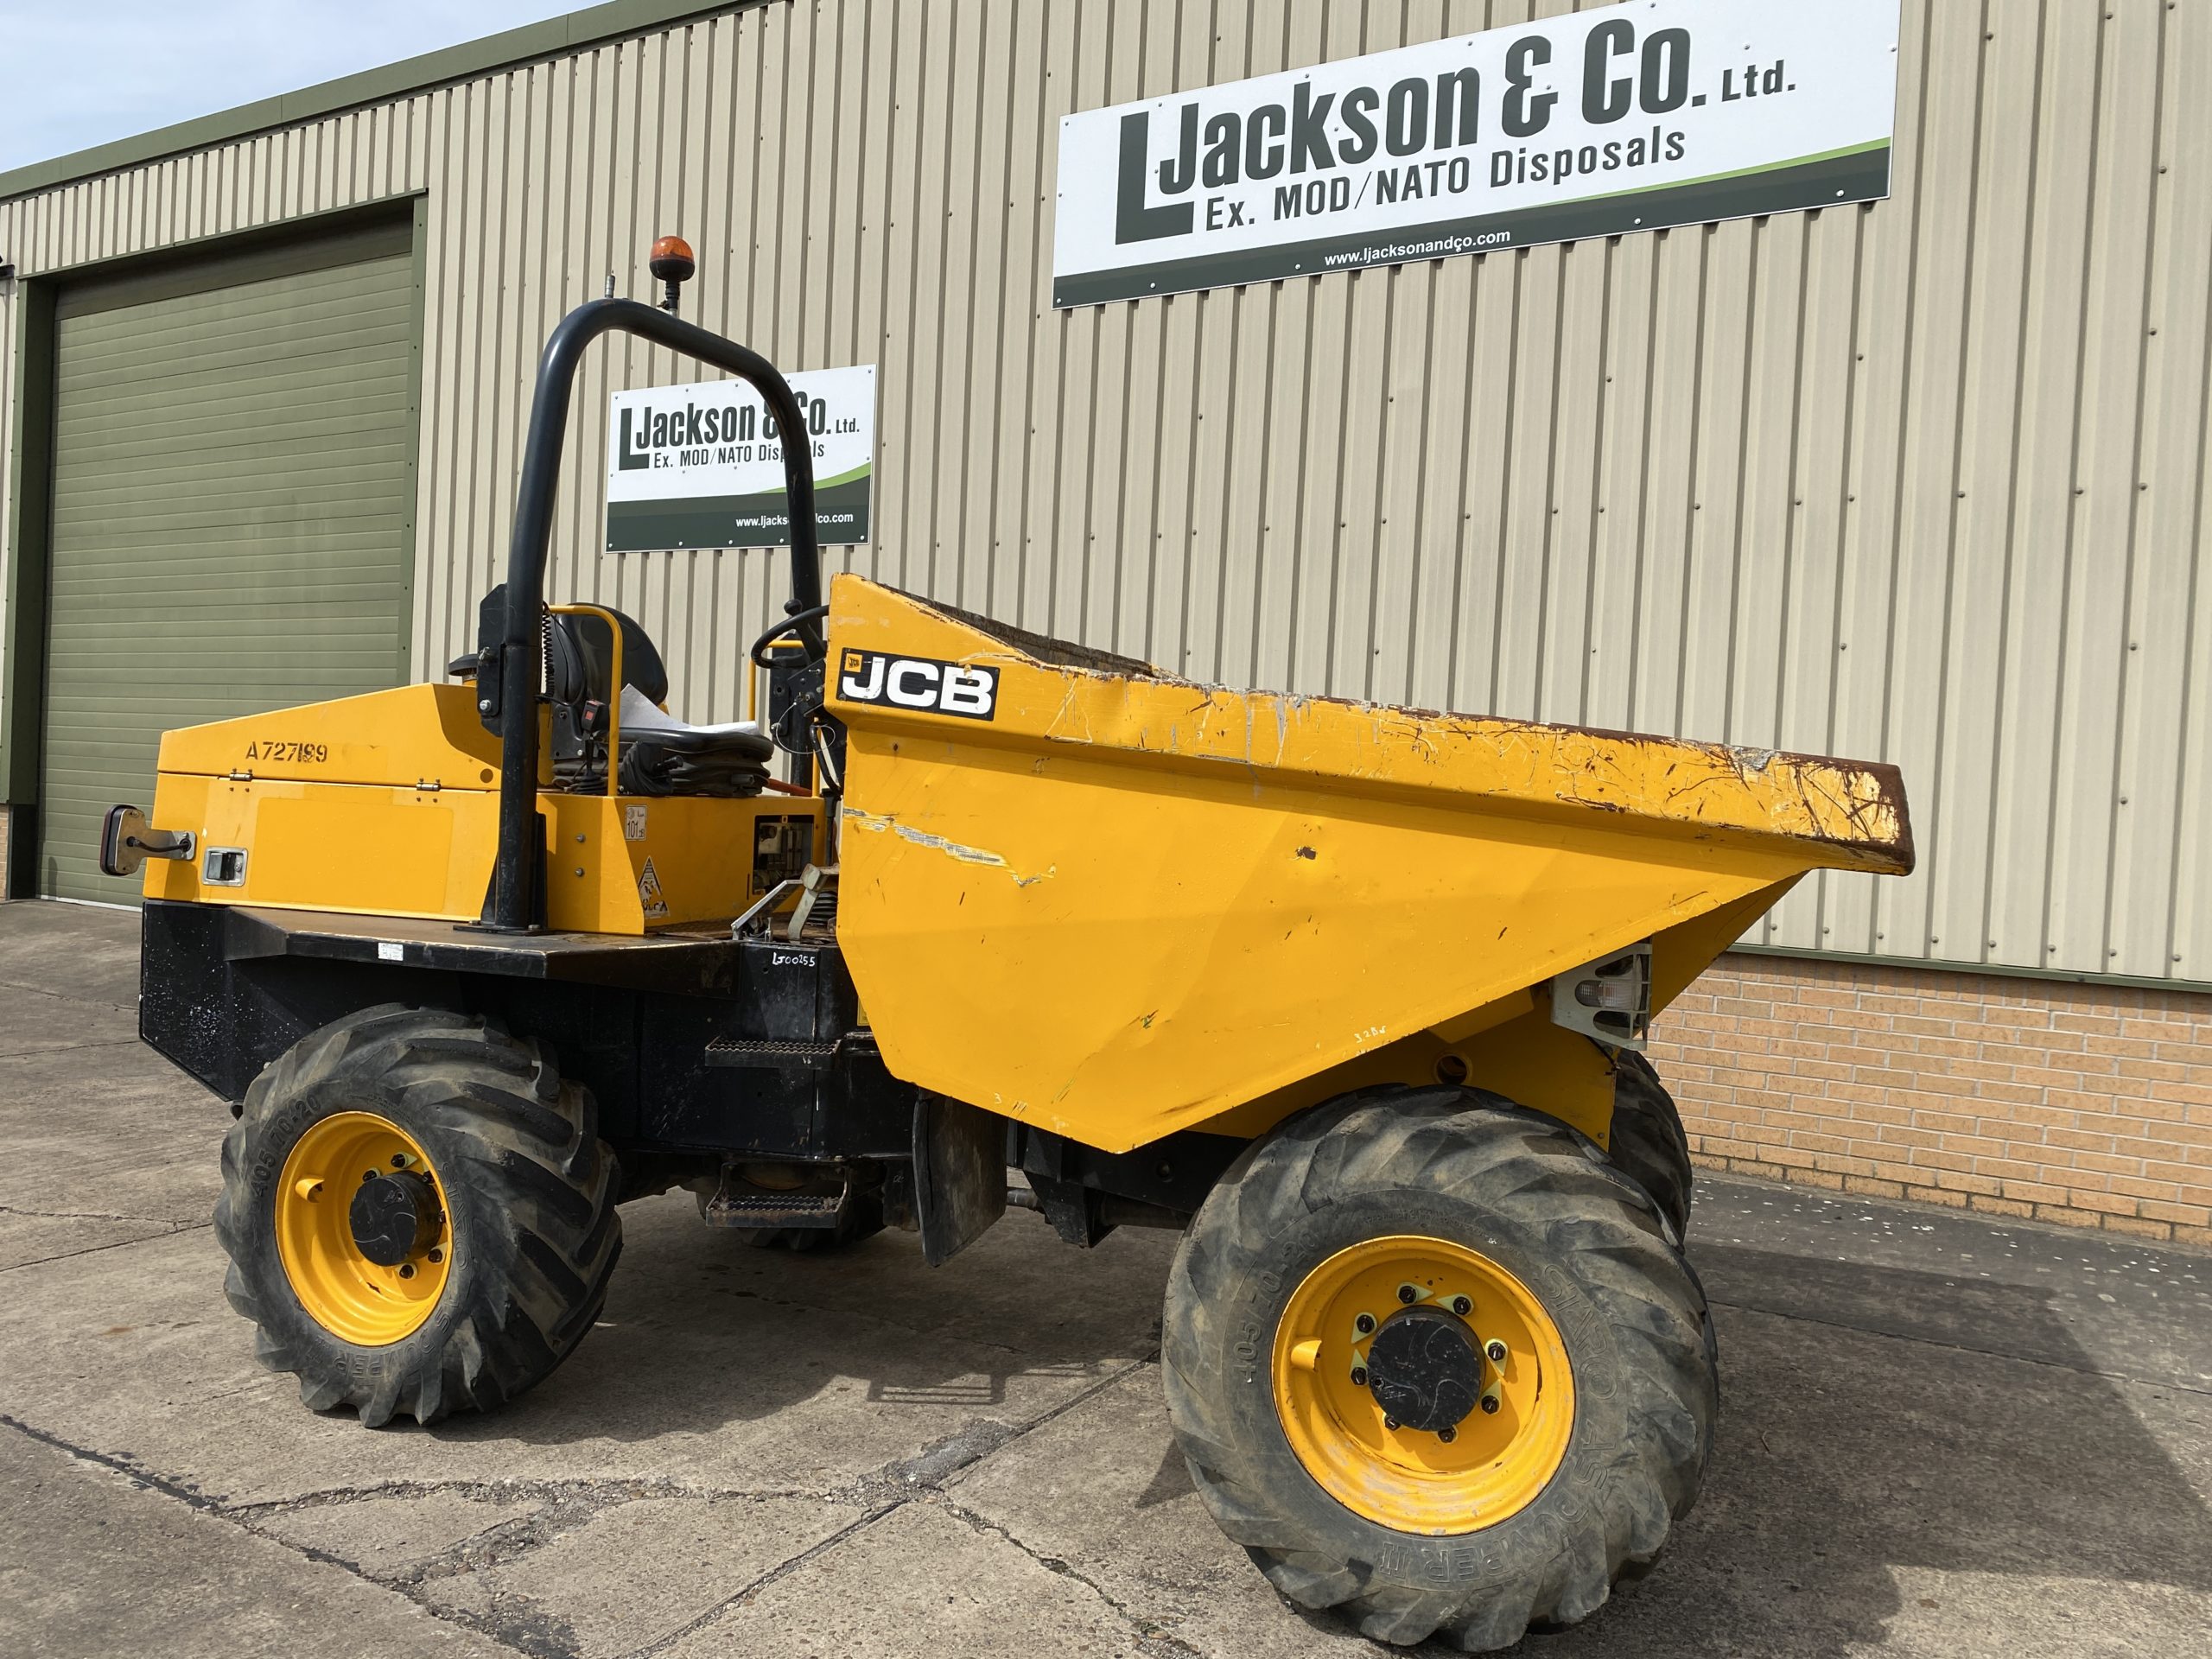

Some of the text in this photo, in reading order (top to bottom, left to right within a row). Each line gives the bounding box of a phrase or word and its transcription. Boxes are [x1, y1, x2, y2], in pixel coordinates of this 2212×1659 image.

[1502, 35, 1559, 137] &
[1582, 19, 1707, 124] Co.
[1722, 60, 1796, 102] Ltd.
[1206, 125, 1685, 232] Ex. MOD/NATO Disposals
[836, 417, 861, 434] Ltd.
[654, 452, 674, 468] Ex.
[680, 445, 752, 467] MOD/NATO
[842, 656, 994, 715] JCB
